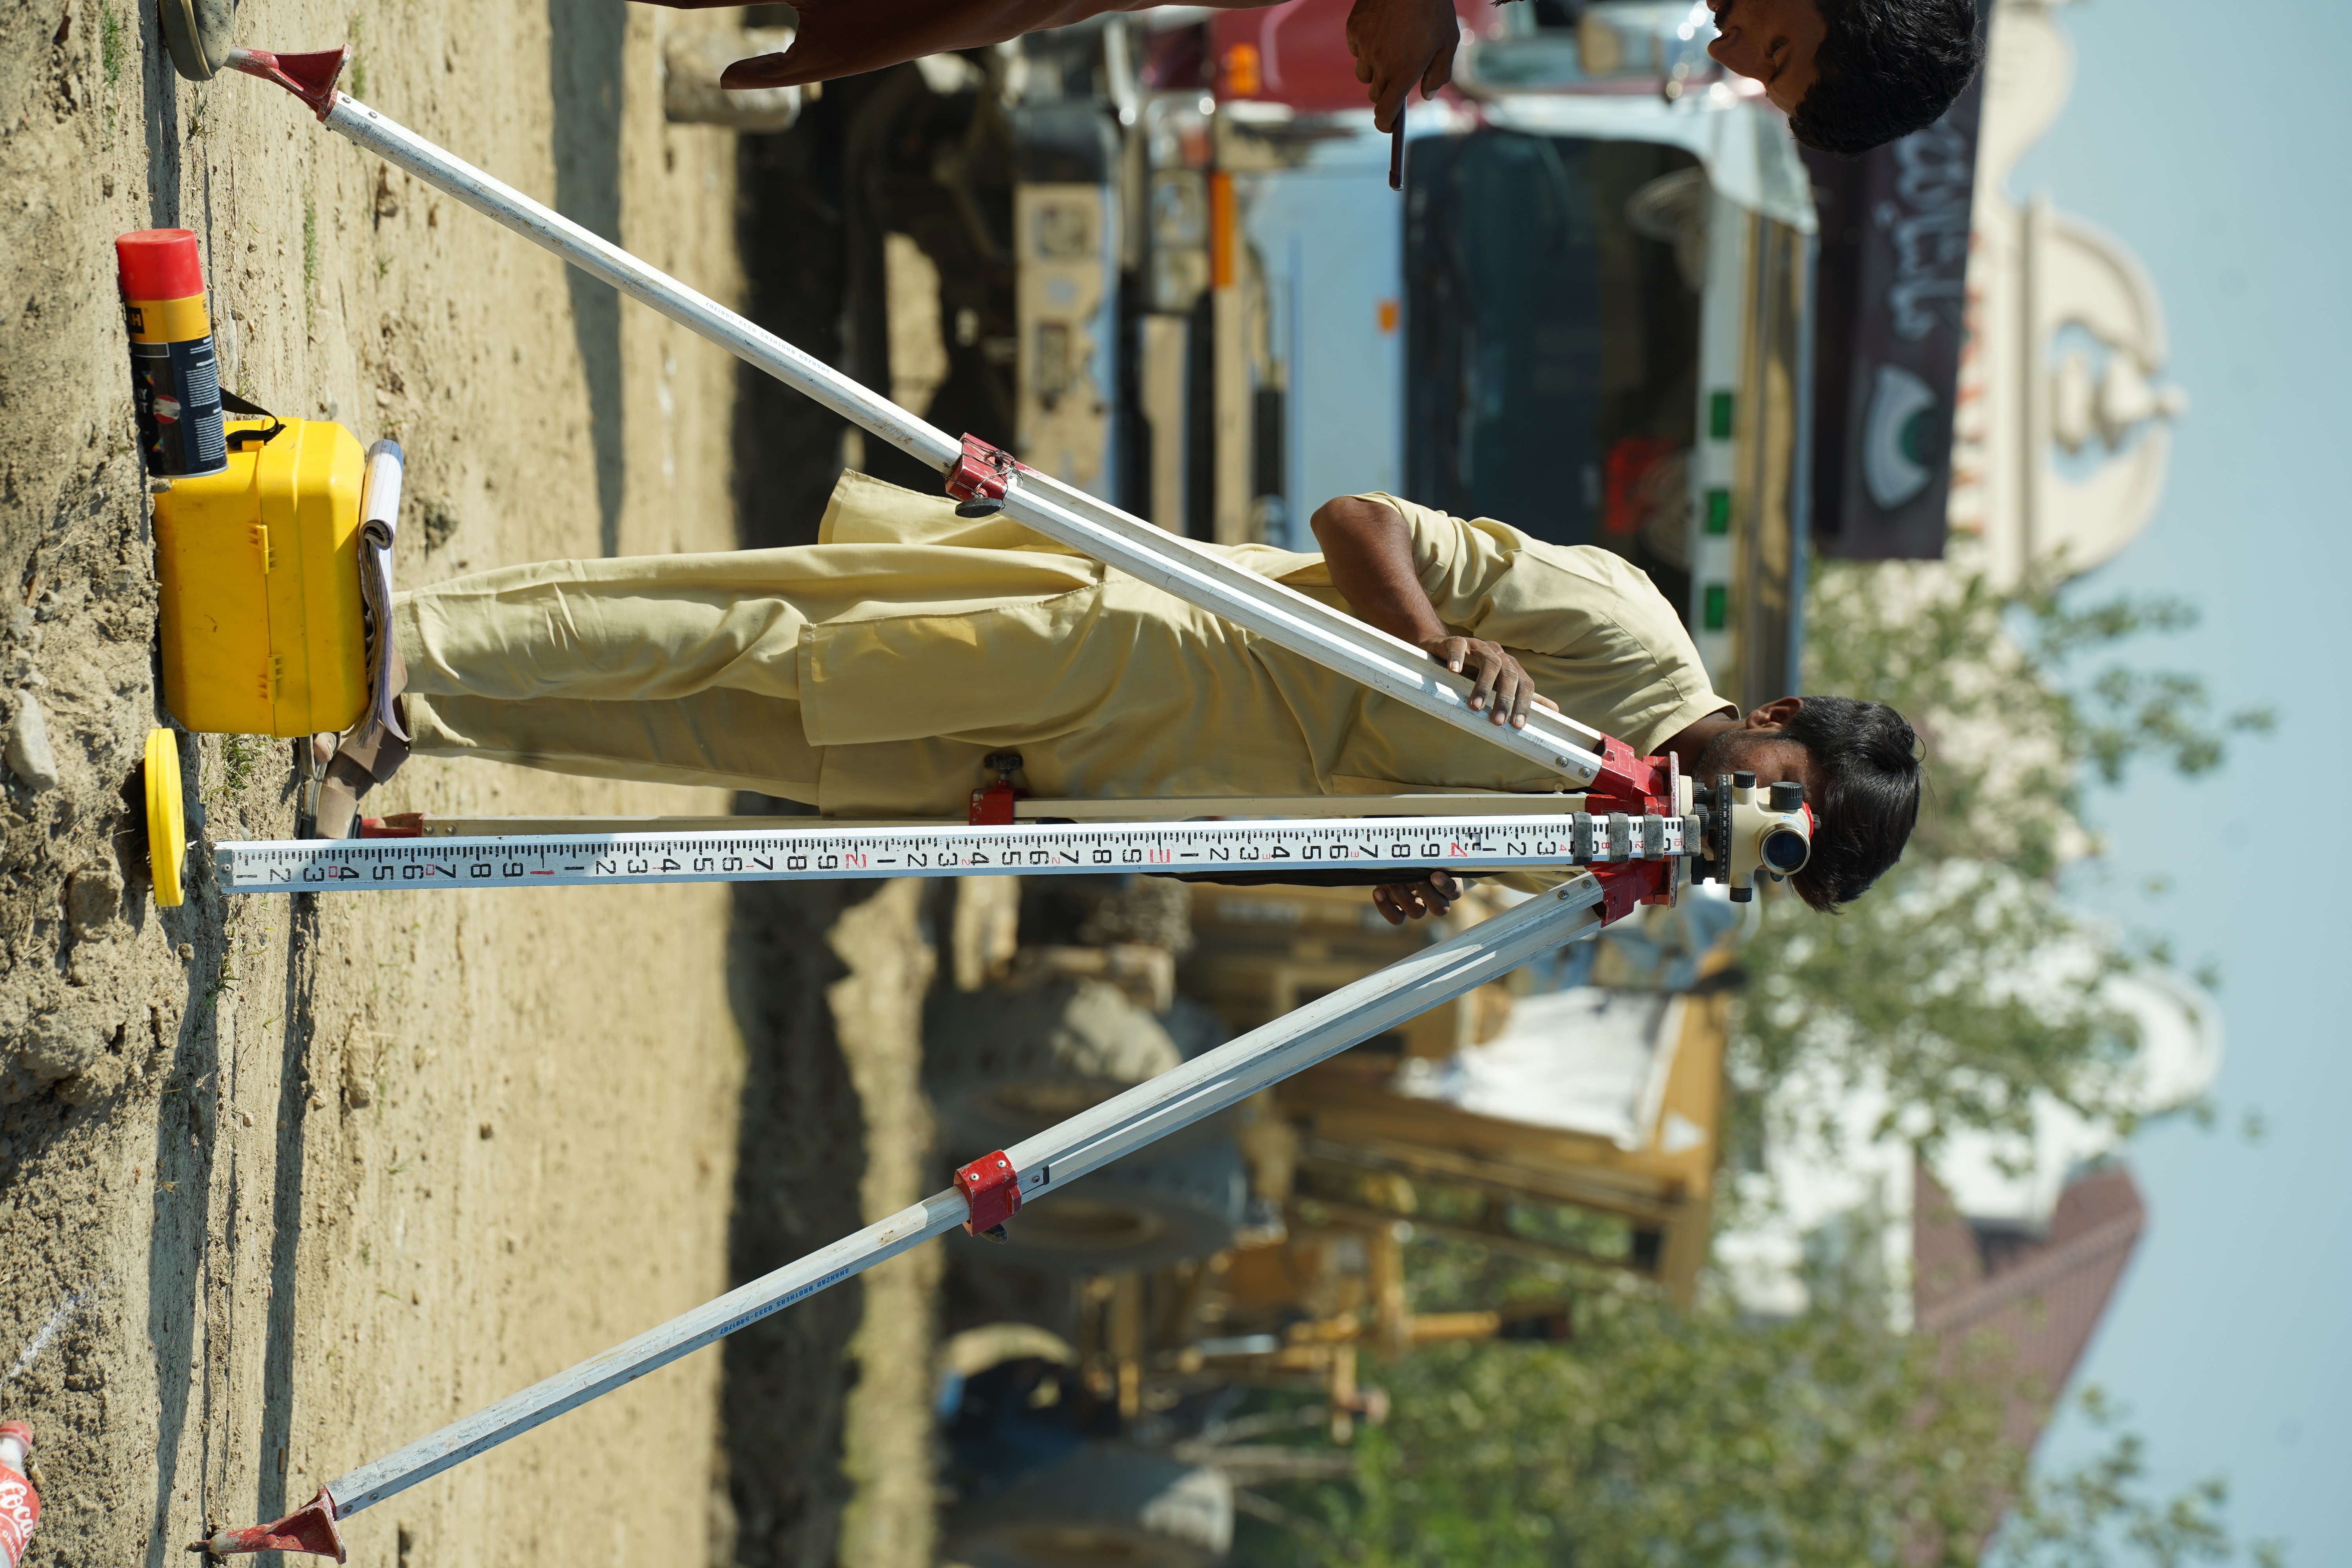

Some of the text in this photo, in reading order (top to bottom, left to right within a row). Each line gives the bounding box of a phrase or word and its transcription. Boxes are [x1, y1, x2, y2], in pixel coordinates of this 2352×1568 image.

[1508, 842, 1526, 855] 2
[1537, 842, 1555, 855] 3
[1635, 840, 1644, 849] 12
[1674, 838, 1682, 846] 16
[1060, 850, 1078, 864] 7
[1093, 850, 1111, 863] 8
[1123, 849, 1142, 862] 9
[1150, 849, 1170, 863] 3
[1210, 848, 1229, 860] 2
[1240, 847, 1258, 860] 3
[1271, 846, 1290, 858] 4
[1303, 846, 1321, 859] 5
[1330, 846, 1348, 858] 6
[1359, 845, 1378, 858] 7
[1392, 844, 1410, 858] 8
[1421, 844, 1439, 857] 9
[1448, 843, 1467, 857] 4
[722, 857, 742, 871] 6
[753, 857, 773, 870] 7
[787, 856, 807, 870] 8
[818, 855, 837, 869] 9
[846, 854, 867, 869] 2
[908, 854, 927, 867] 2
[938, 853, 957, 866] 3
[971, 852, 989, 866] 4
[1002, 851, 1021, 865] 5
[1030, 851, 1049, 864] 6
[328, 866, 337, 878] 0
[403, 865, 423, 879] 6
[426, 864, 434, 876] 0
[435, 864, 456, 878] 7
[471, 864, 491, 878] 8
[503, 863, 523, 877] 9
[596, 860, 616, 874] 2
[628, 859, 648, 873] 3
[661, 859, 681, 873] 4
[694, 858, 713, 872] 5
[270, 868, 290, 882] 2
[303, 867, 324, 882] 3
[338, 867, 359, 881] 4
[373, 866, 394, 880] 5
[720, 1267, 849, 1334] SHAHZAD BROTHERS 0333-5481707
[0, 1481, 33, 1538] Coca
